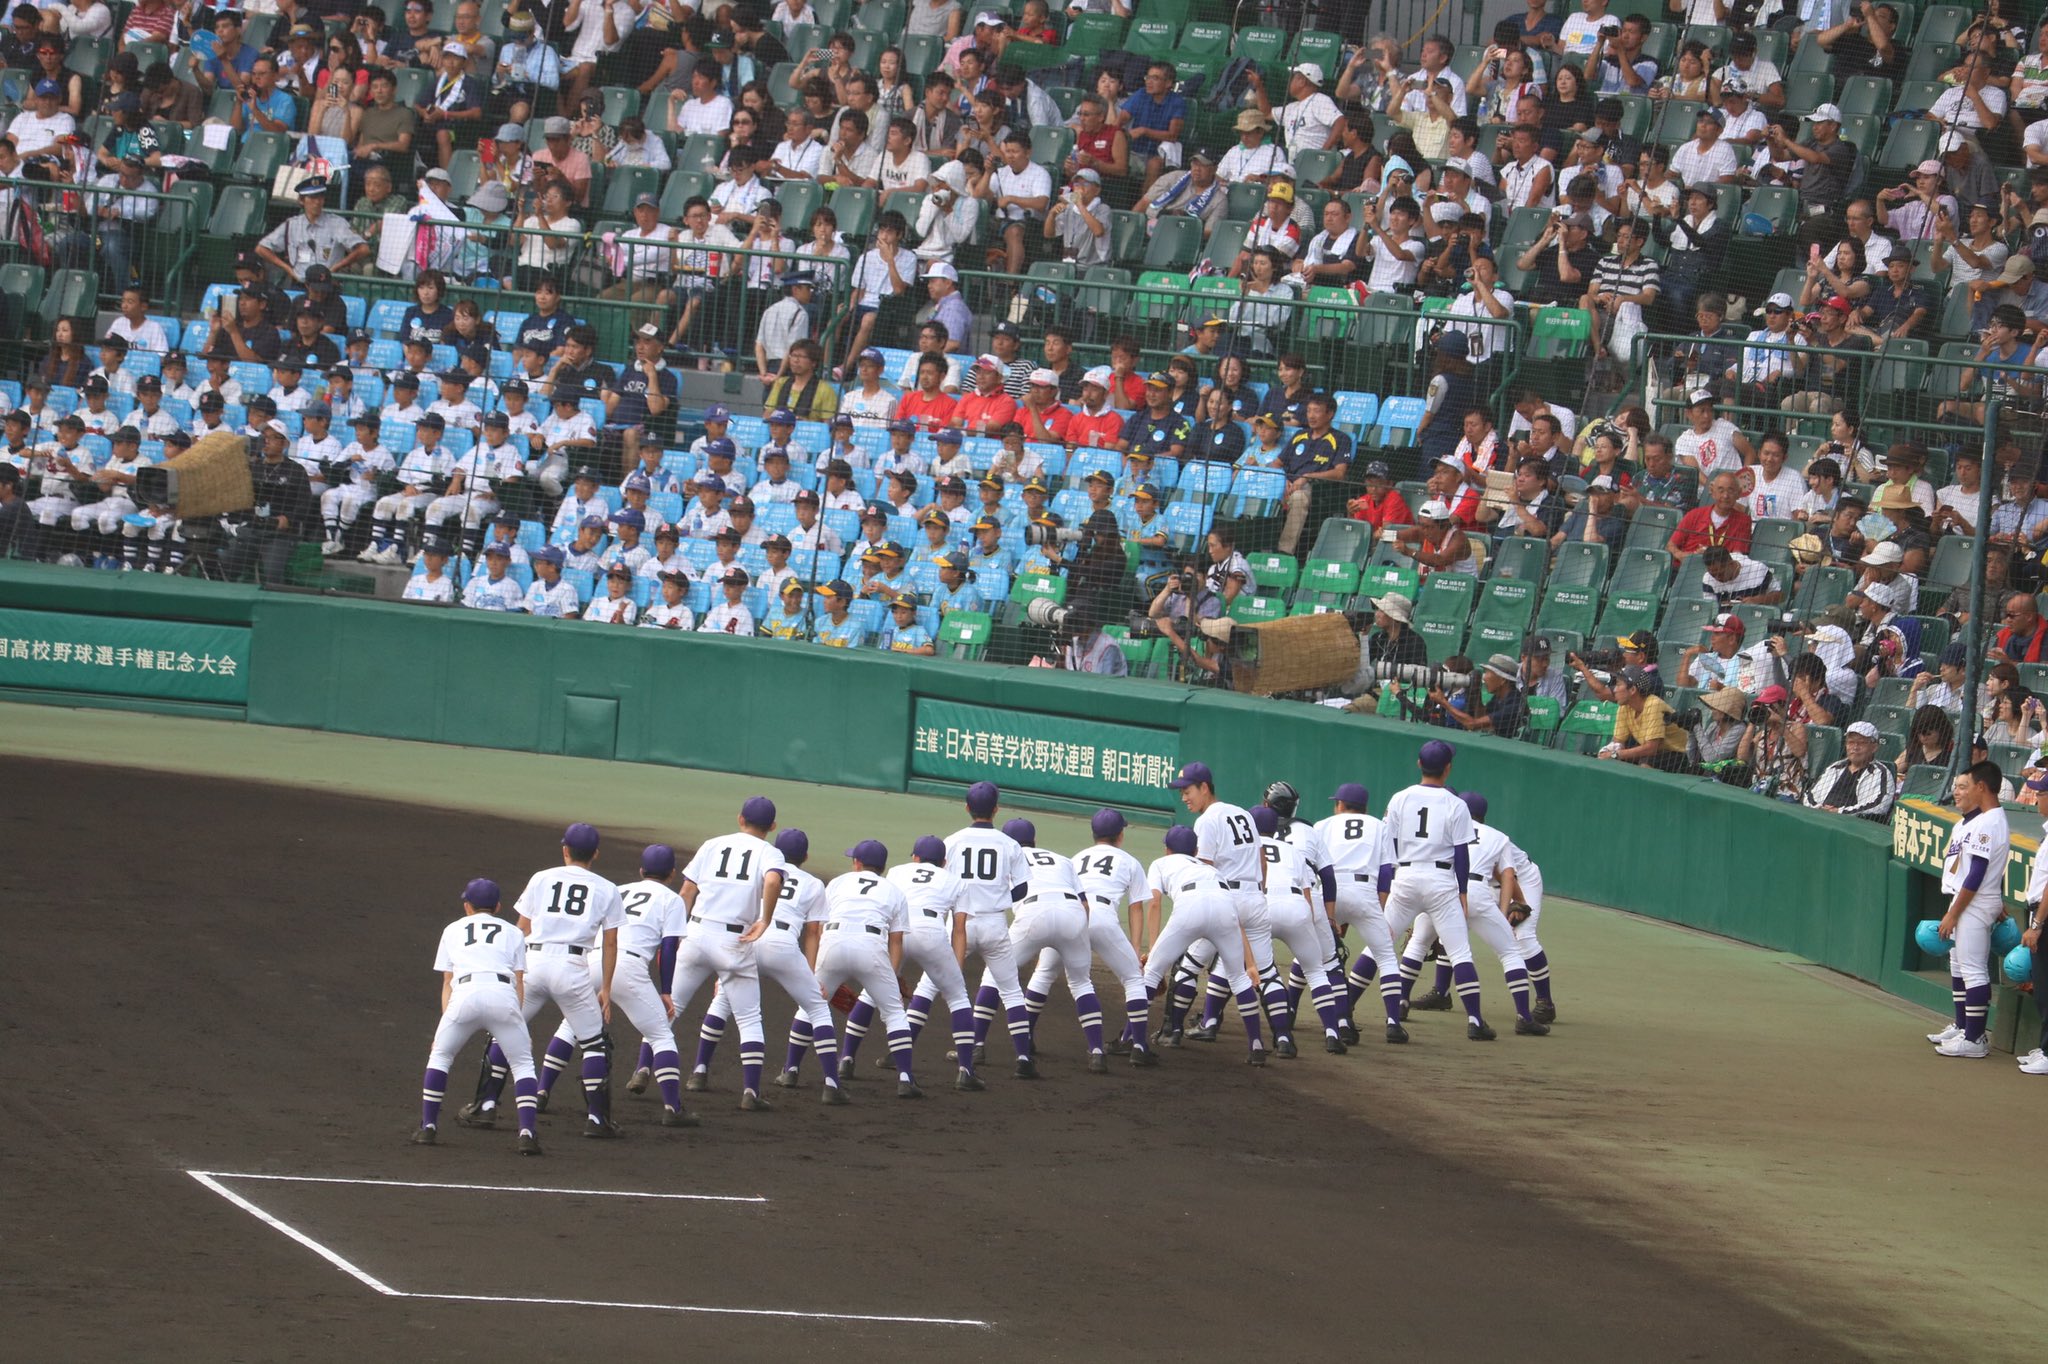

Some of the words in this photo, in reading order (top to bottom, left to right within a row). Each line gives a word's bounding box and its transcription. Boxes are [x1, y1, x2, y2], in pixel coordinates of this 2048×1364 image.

[1101, 748, 1175, 790] 朝日新聞社
[1226, 815, 1254, 846] 13
[1344, 819, 1364, 840] 8
[1415, 806, 1429, 839] 1
[1894, 806, 1951, 869] 椿本チエ
[715, 846, 753, 881] 11
[961, 848, 998, 881] 10
[1077, 855, 1114, 876] 14
[1262, 844, 1281, 864] 9
[858, 877, 879, 895] 7
[912, 868, 935, 884] 3
[548, 881, 589, 916] 18
[464, 923, 502, 946] 17
